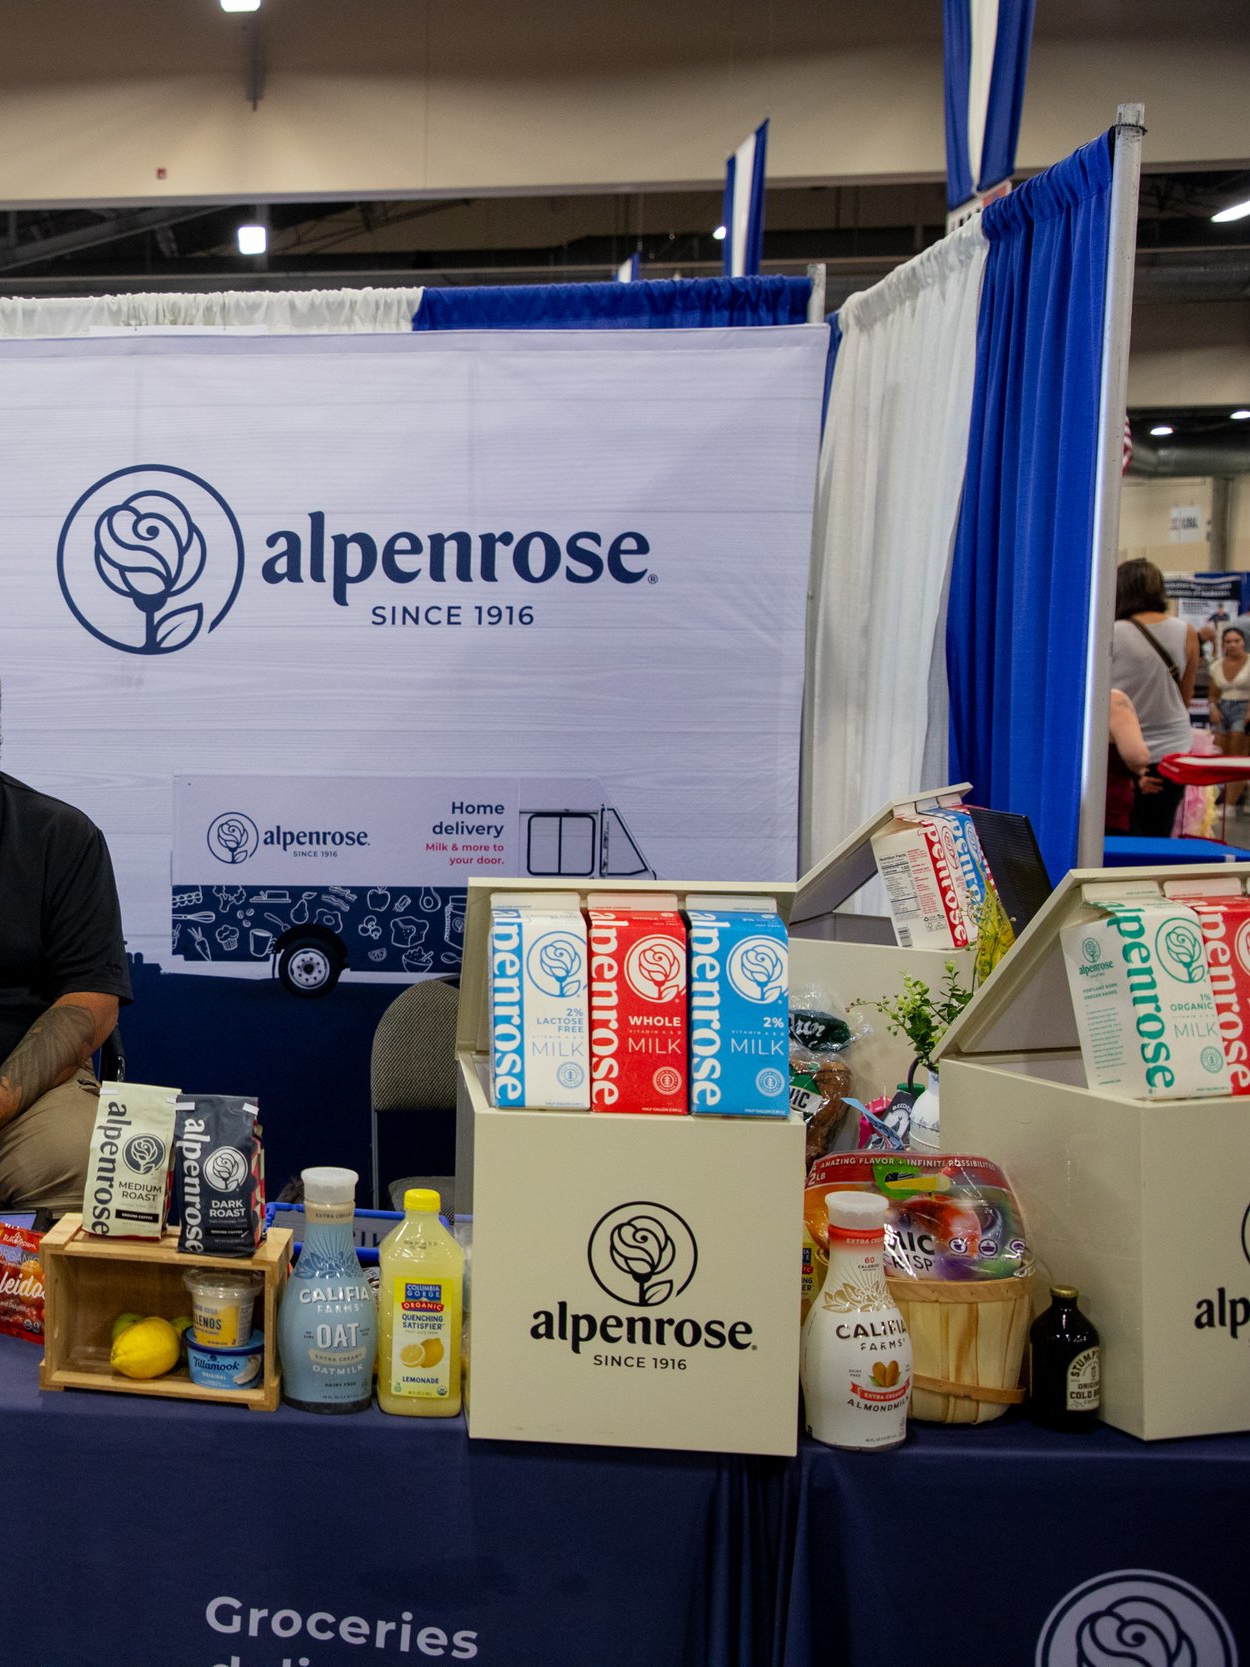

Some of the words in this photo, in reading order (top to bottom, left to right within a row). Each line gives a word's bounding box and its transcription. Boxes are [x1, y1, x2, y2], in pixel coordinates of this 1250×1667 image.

[372, 606, 463, 626] SINCE
[474, 606, 534, 626] 1916
[451, 801, 505, 815] Home
[432, 821, 505, 839] delivery
[425, 842, 448, 851] Milk
[451, 843, 458, 851] &
[449, 857, 473, 866] your
[477, 856, 504, 864] door.
[1079, 960, 1115, 976] alpenrose
[1093, 901, 1175, 1088] alpenrose
[491, 909, 531, 1100] alpenrose
[588, 911, 629, 1105] alpenrose
[687, 911, 730, 1106] alpenrose
[1170, 1002, 1213, 1012] ORGANIC
[566, 1008, 584, 1017] 2%
[628, 1016, 681, 1027] WHOLE
[763, 1016, 784, 1028] 2%
[1174, 1022, 1219, 1038] MILK
[532, 1041, 584, 1057] MILK
[628, 1037, 681, 1054] MILK
[731, 1038, 784, 1056] MILK
[92, 1101, 132, 1235] alpenrose
[820, 1158, 856, 1169] AMAZING
[907, 1159, 947, 1167] INFINITE
[118, 1181, 162, 1194] MEDIUM
[176, 1118, 211, 1252] alpenrose
[122, 1191, 158, 1202] ROAST
[212, 1200, 244, 1209] DARK
[209, 1208, 246, 1218] ROAST
[864, 1256, 875, 1264] 60
[299, 1286, 370, 1304] CALIFIA
[403, 1302, 443, 1311] ORGANIC
[402, 1313, 443, 1322] QUENCHING
[402, 1322, 443, 1330] SATISFIER
[317, 1322, 360, 1349] OAT
[861, 1339, 903, 1351] FARMS
[193, 1355, 240, 1371] Tillamook
[315, 1354, 336, 1362] EXTRA
[339, 1353, 363, 1362] CREAMY
[593, 1354, 646, 1369] SINCE
[652, 1357, 687, 1371] 1916
[312, 1363, 364, 1375] OATMILK
[402, 1376, 439, 1384] LEMONADE
[1070, 1390, 1092, 1399] COLD
[205, 1596, 479, 1659] Groceries
